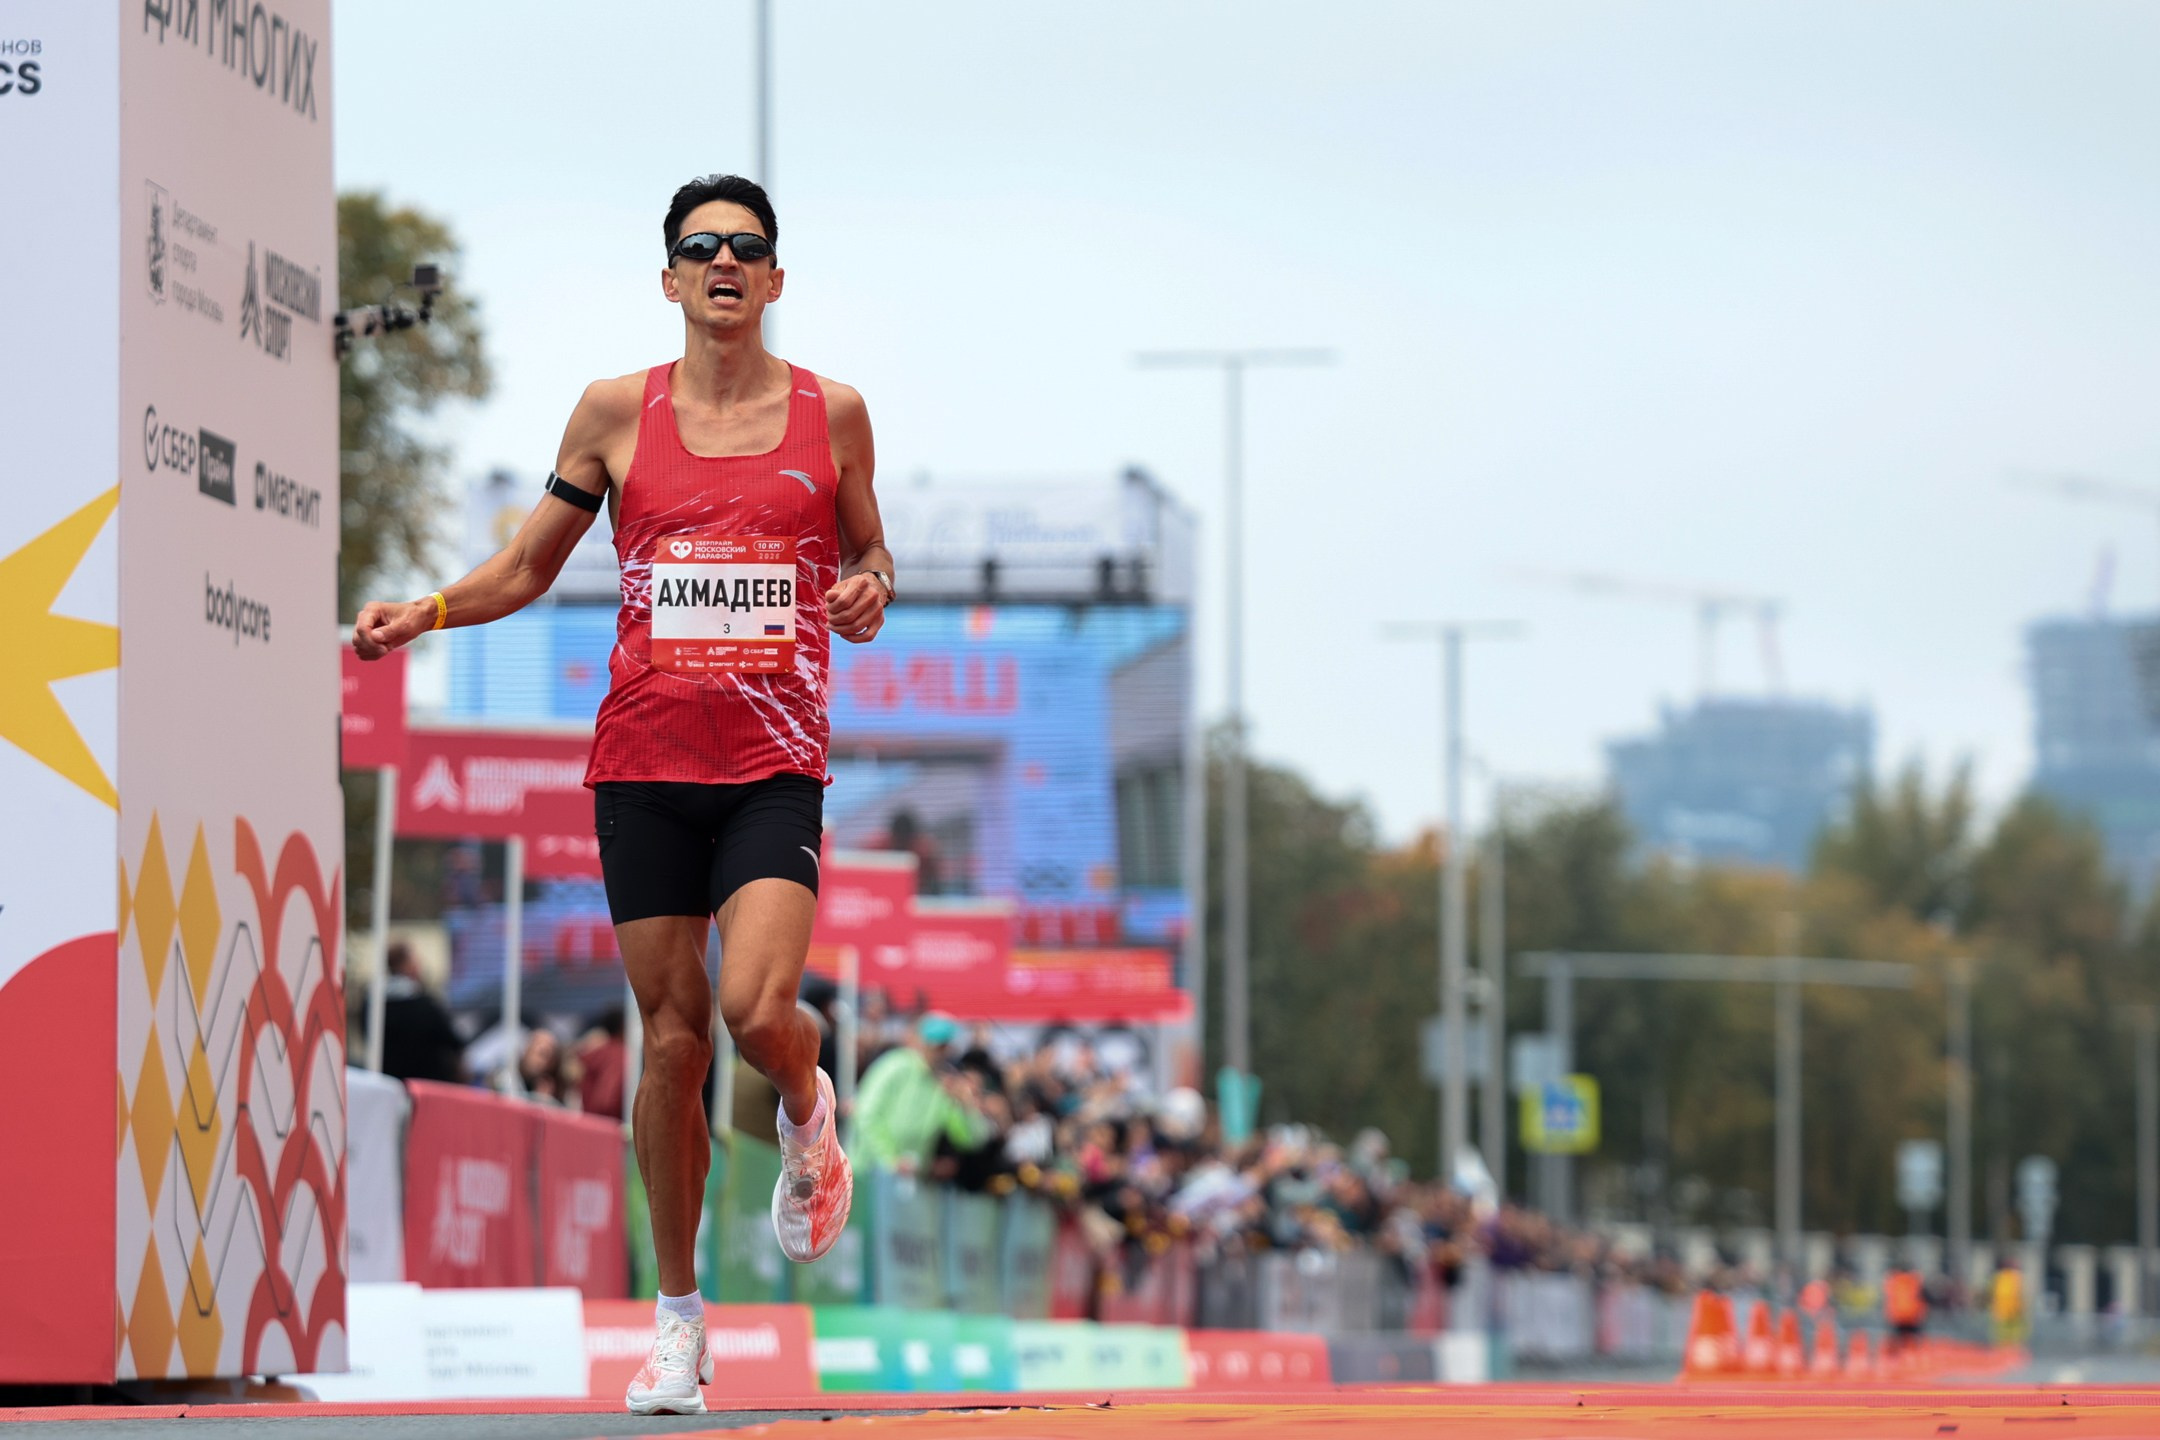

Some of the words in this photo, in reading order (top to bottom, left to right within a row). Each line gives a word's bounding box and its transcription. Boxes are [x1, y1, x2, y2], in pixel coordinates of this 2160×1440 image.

[0, 39, 42, 55] НОВ
[162, 424, 198, 476] СБЕР
[695, 545, 747, 553] МОСКОВСКИЙ
[757, 542, 767, 550] 10
[657, 578, 793, 613] АХМАДЕЕВ
[205, 569, 271, 647] bodycore
[723, 623, 731, 634] 3
